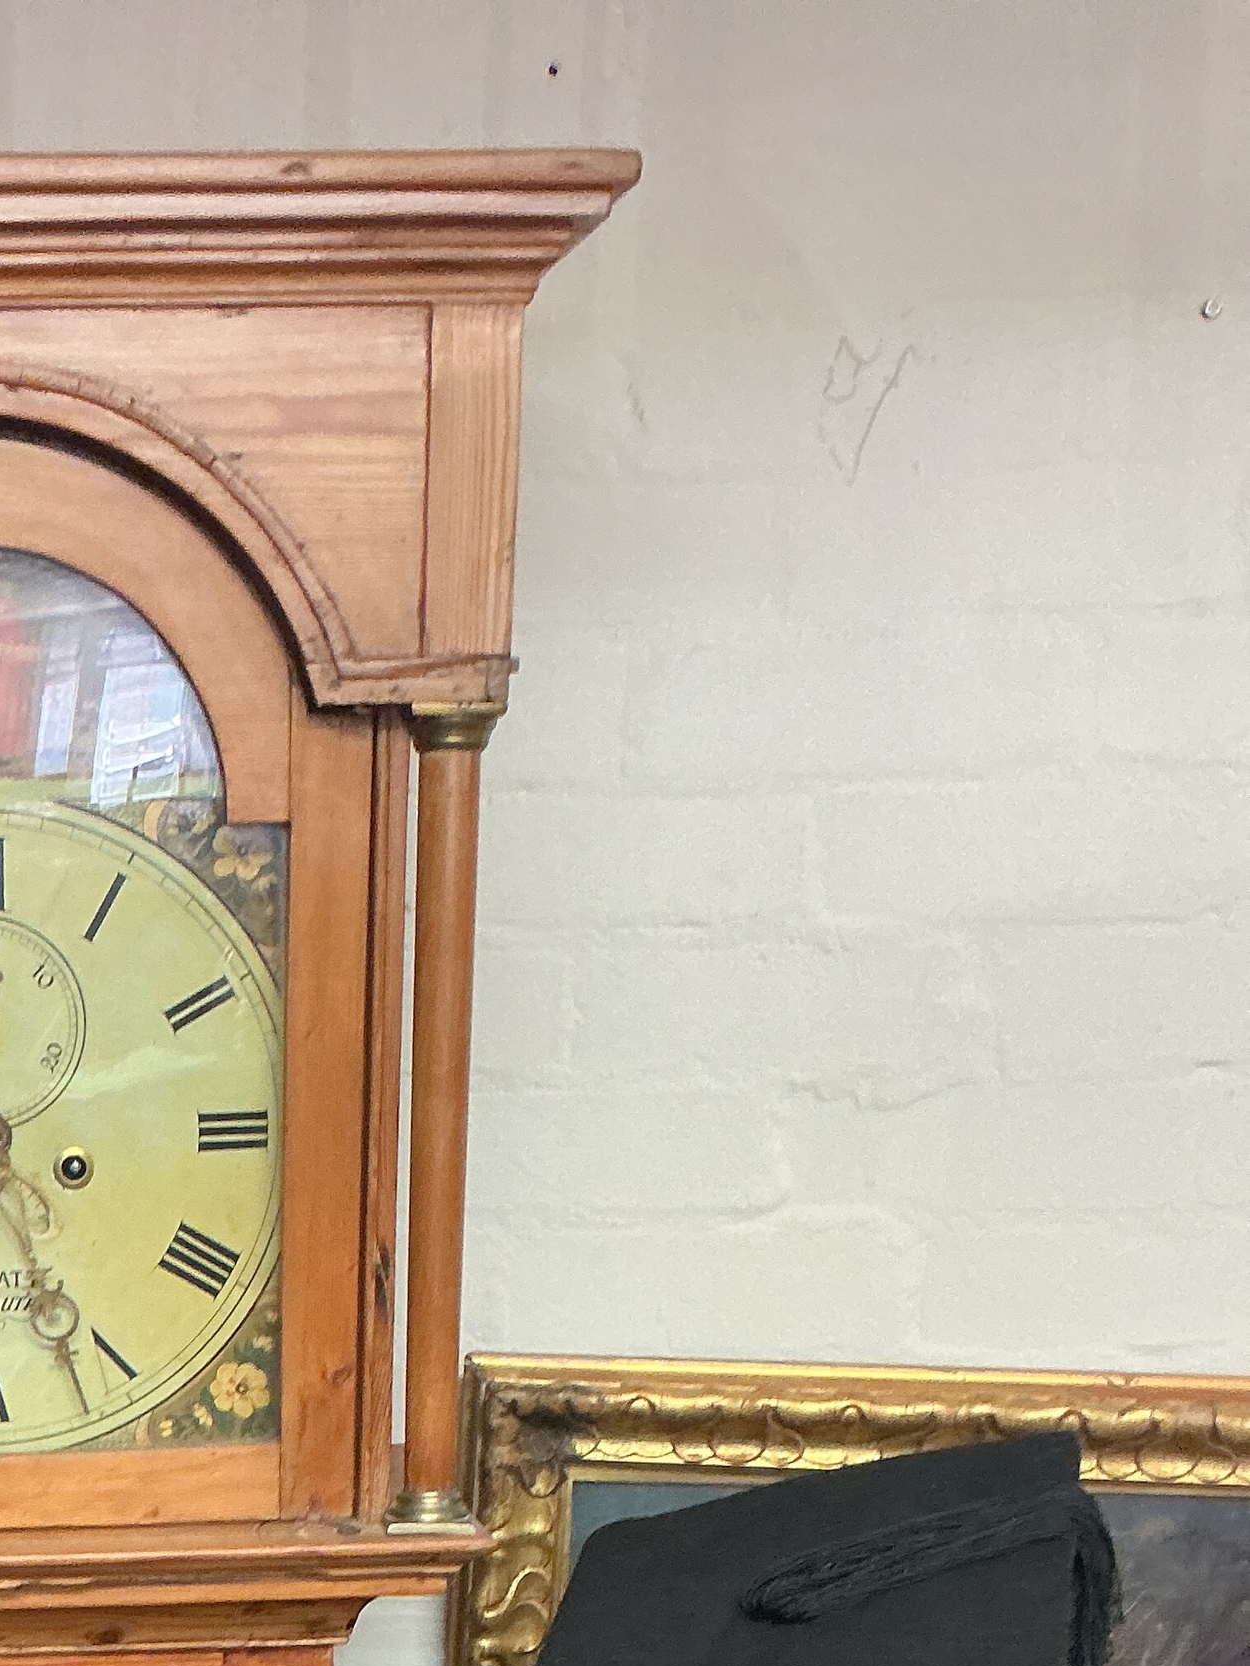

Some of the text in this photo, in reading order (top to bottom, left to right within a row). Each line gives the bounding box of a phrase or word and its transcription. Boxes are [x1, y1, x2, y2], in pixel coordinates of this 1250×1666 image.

[82, 871, 127, 943] I
[32, 963, 54, 990] 10
[163, 974, 238, 1034] II
[40, 1041, 62, 1073] 20
[196, 1109, 269, 1153] III
[152, 1219, 242, 1300] IIII
[91, 1326, 141, 1396] V
